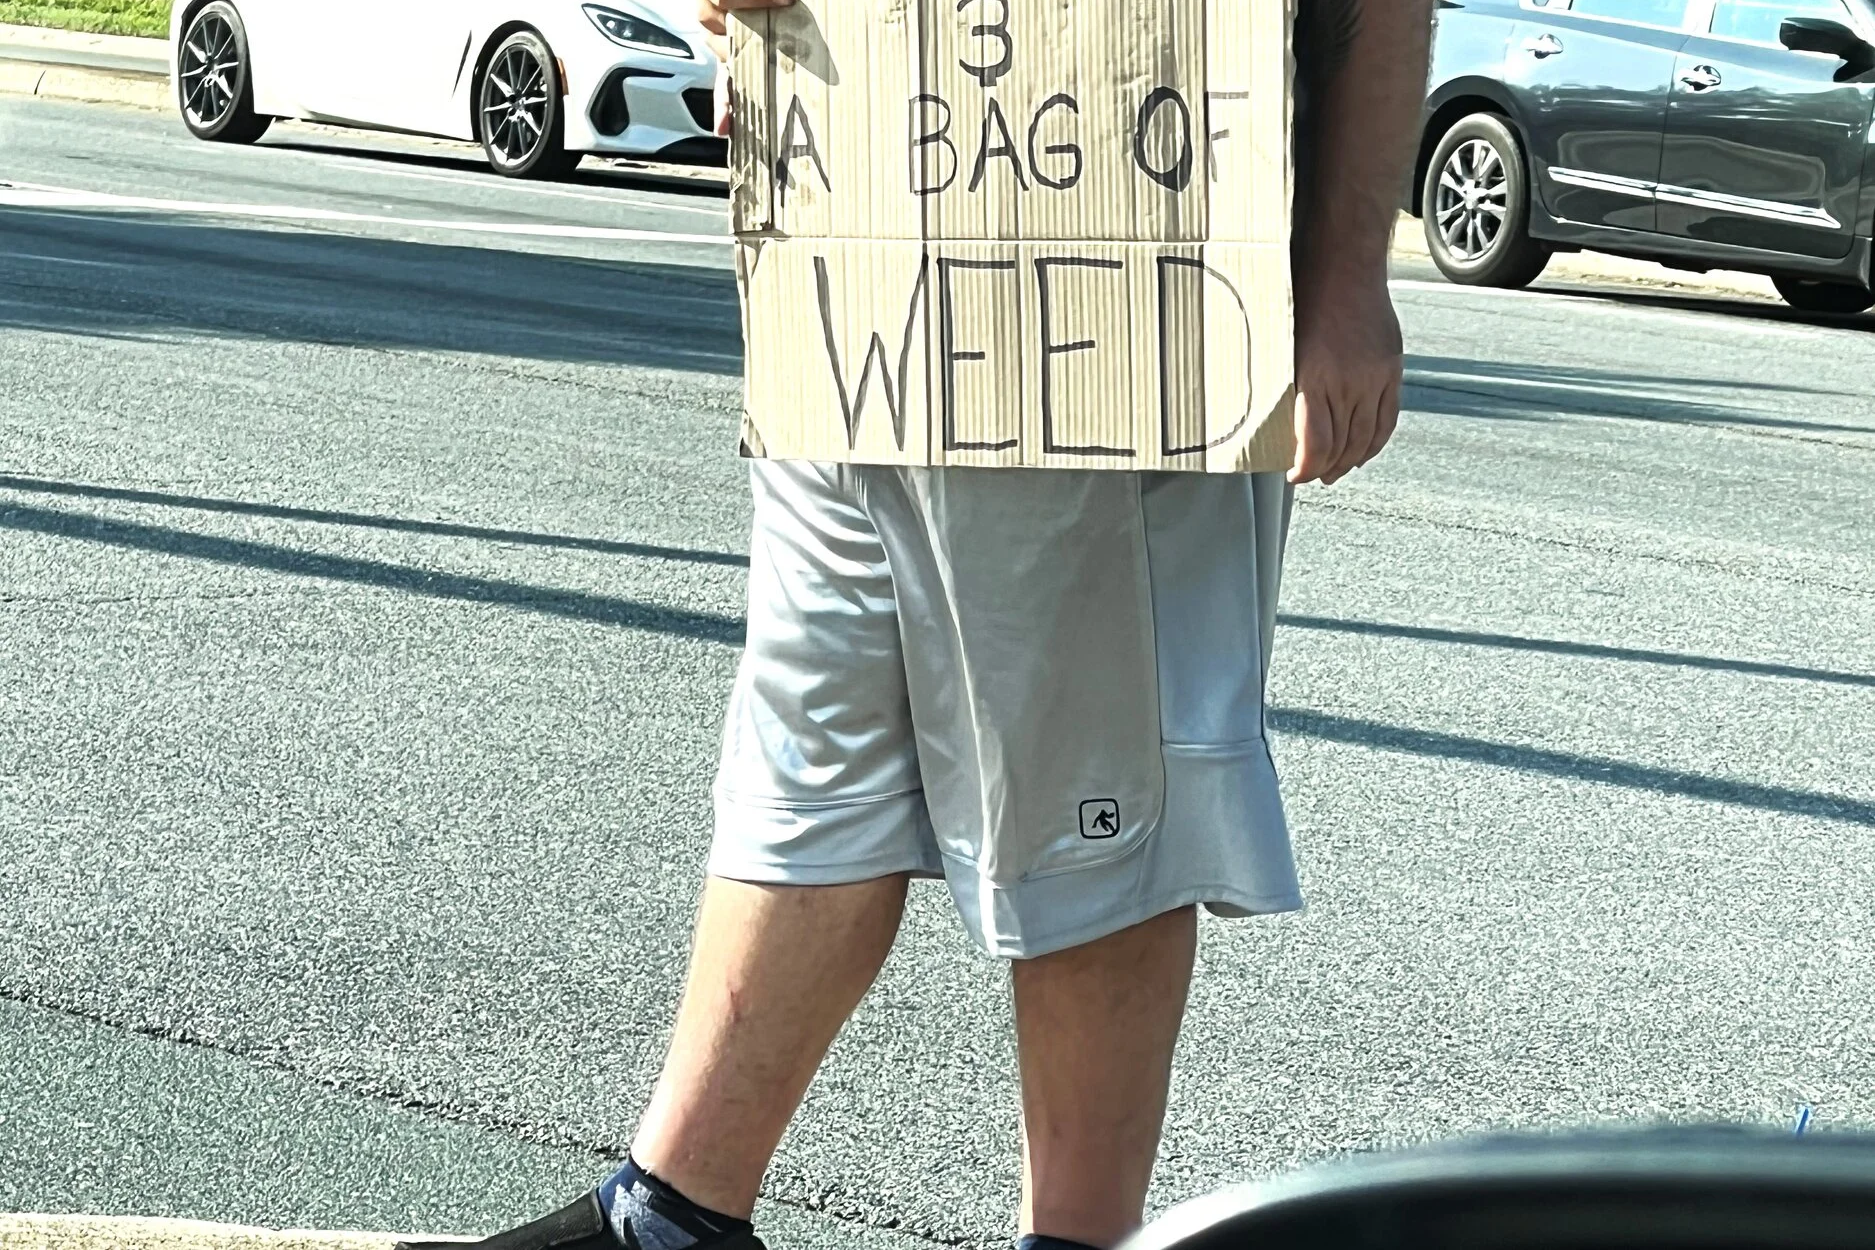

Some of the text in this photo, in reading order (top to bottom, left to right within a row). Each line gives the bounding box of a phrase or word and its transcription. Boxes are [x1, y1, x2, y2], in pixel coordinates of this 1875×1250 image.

[775, 85, 1250, 196] A BAG OF
[812, 253, 1253, 458] WEED
